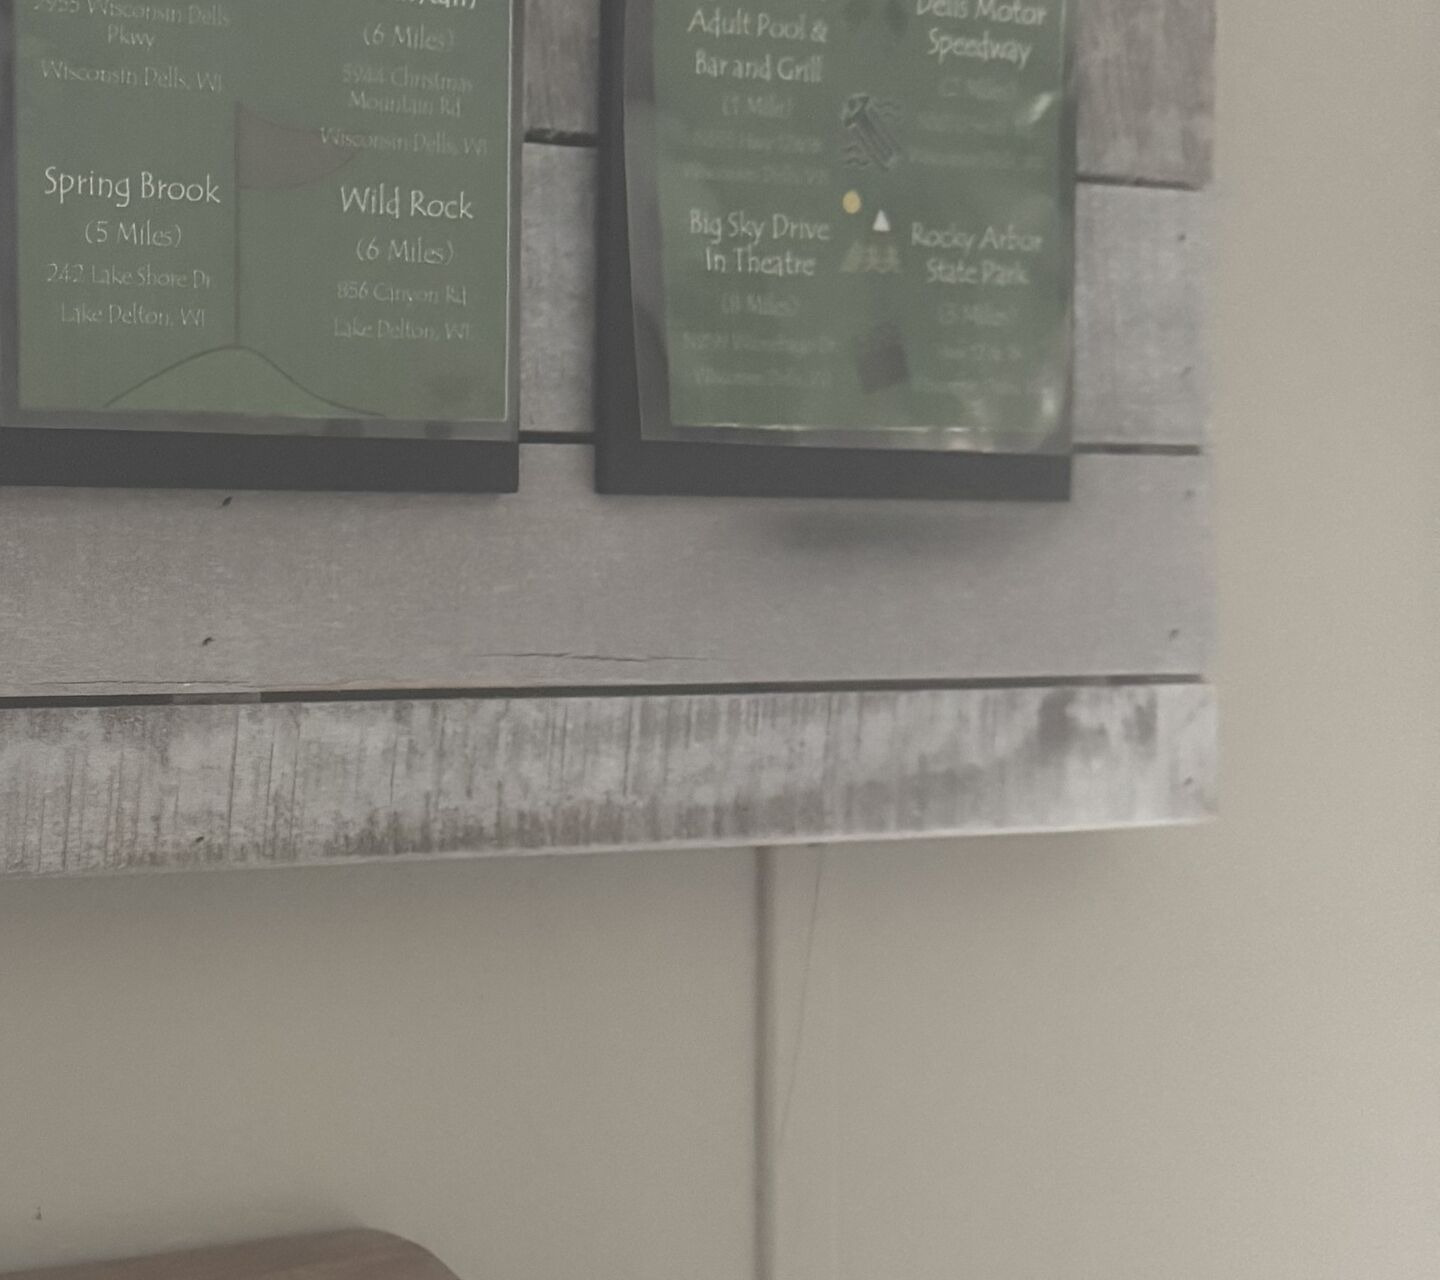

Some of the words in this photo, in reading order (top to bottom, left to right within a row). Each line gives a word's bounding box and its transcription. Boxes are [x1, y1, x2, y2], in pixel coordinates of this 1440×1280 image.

[107, 24, 156, 50] Pkwy
[363, 22, 385, 47] (6
[391, 24, 455, 52] Miles)
[688, 8, 751, 39] Adult
[757, 12, 806, 40] Pool
[810, 19, 828, 44] &
[927, 27, 1033, 71] Speedway
[40, 57, 138, 85] Wisconsin
[695, 48, 729, 78] Bar
[732, 53, 772, 82] and
[777, 55, 824, 84] Grill
[43, 166, 131, 208] Spring
[140, 170, 222, 204] Brook
[339, 182, 400, 219] Wild
[410, 190, 475, 220] Rock
[84, 219, 109, 244] (5
[116, 220, 183, 248] Miles)
[689, 208, 723, 245] Big
[727, 211, 766, 245] Sky
[772, 213, 832, 241] Drive
[911, 222, 975, 256] Rocky
[979, 225, 1044, 252] Arbor
[355, 237, 380, 261] (6
[387, 237, 455, 265] Miles)
[705, 247, 727, 273] In
[732, 245, 817, 277] Theatre
[91, 264, 133, 285] Lake
[138, 264, 187, 287] Shore
[926, 258, 978, 285] State
[982, 261, 1030, 286] Park
[61, 302, 103, 324] Lake
